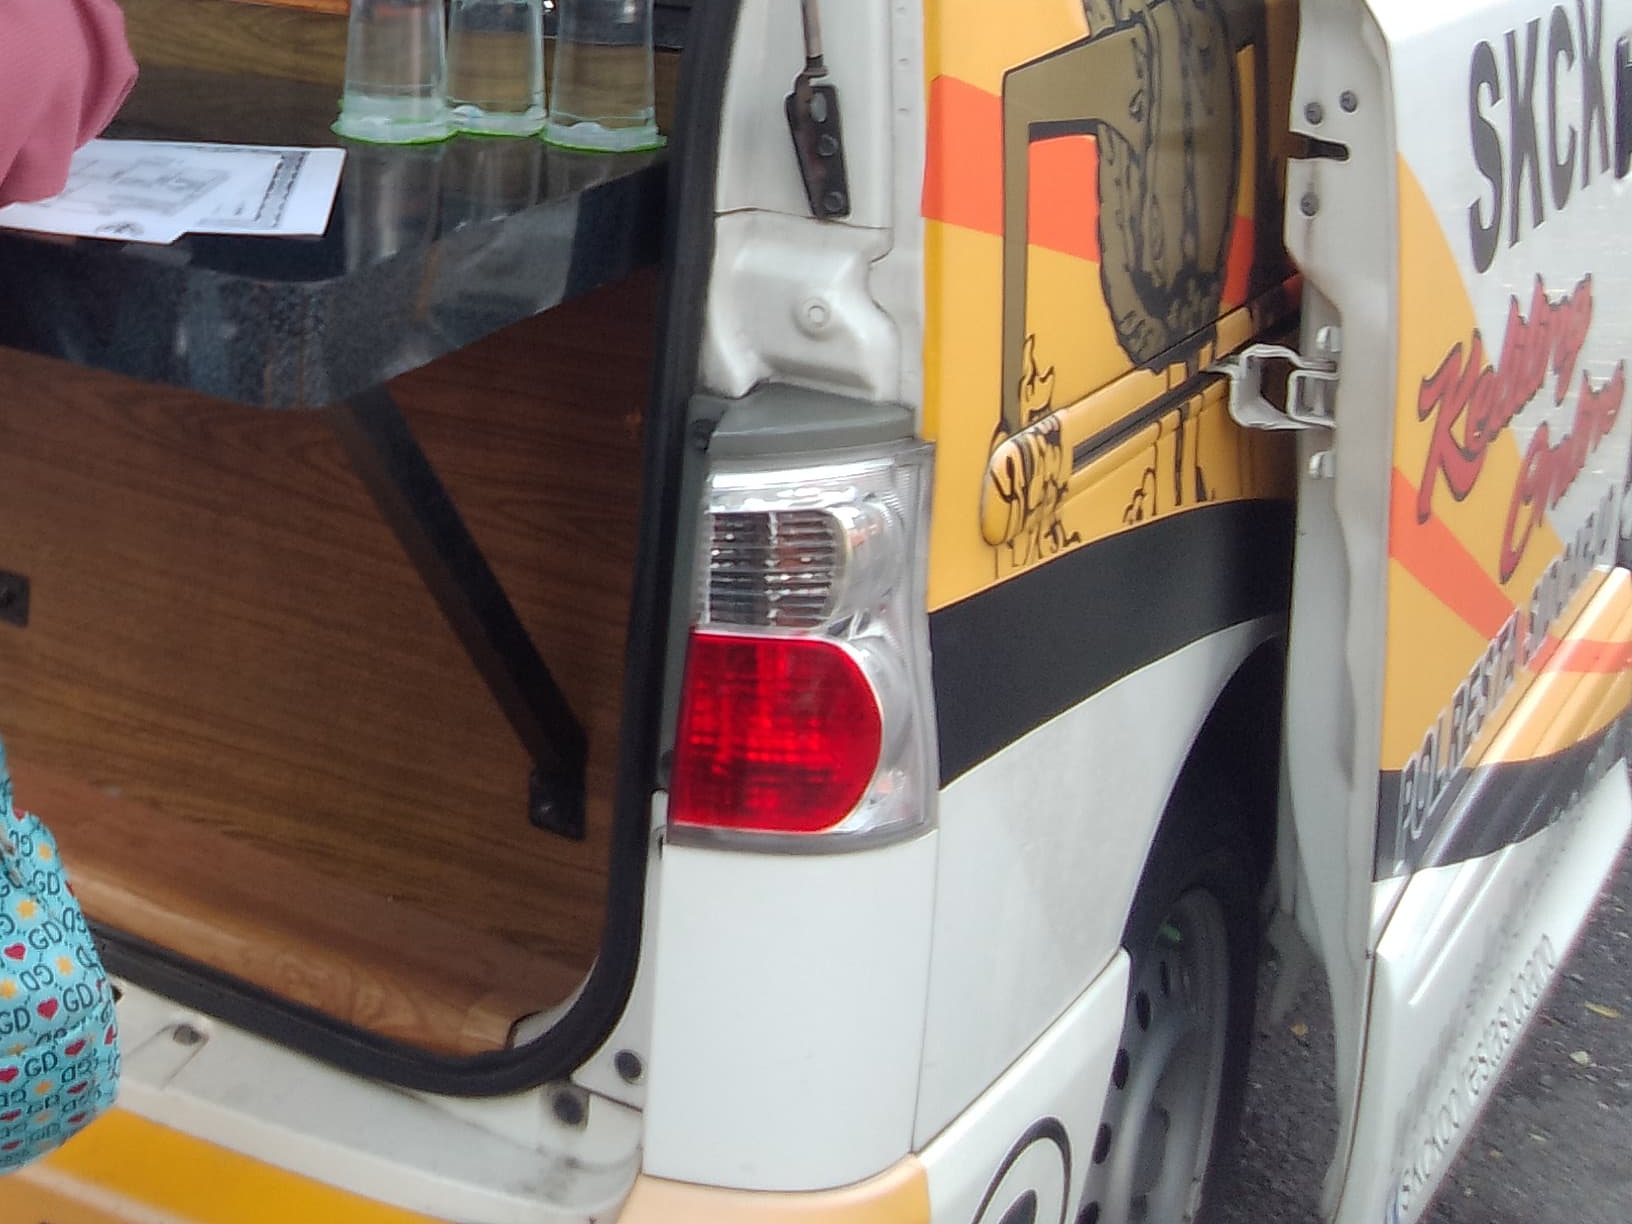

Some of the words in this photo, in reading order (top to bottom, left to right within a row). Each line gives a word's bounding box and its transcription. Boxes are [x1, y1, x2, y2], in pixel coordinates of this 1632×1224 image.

[28, 921, 62, 950] GD
[62, 983, 93, 1012] GD
[24, 1051, 58, 1077] GD
